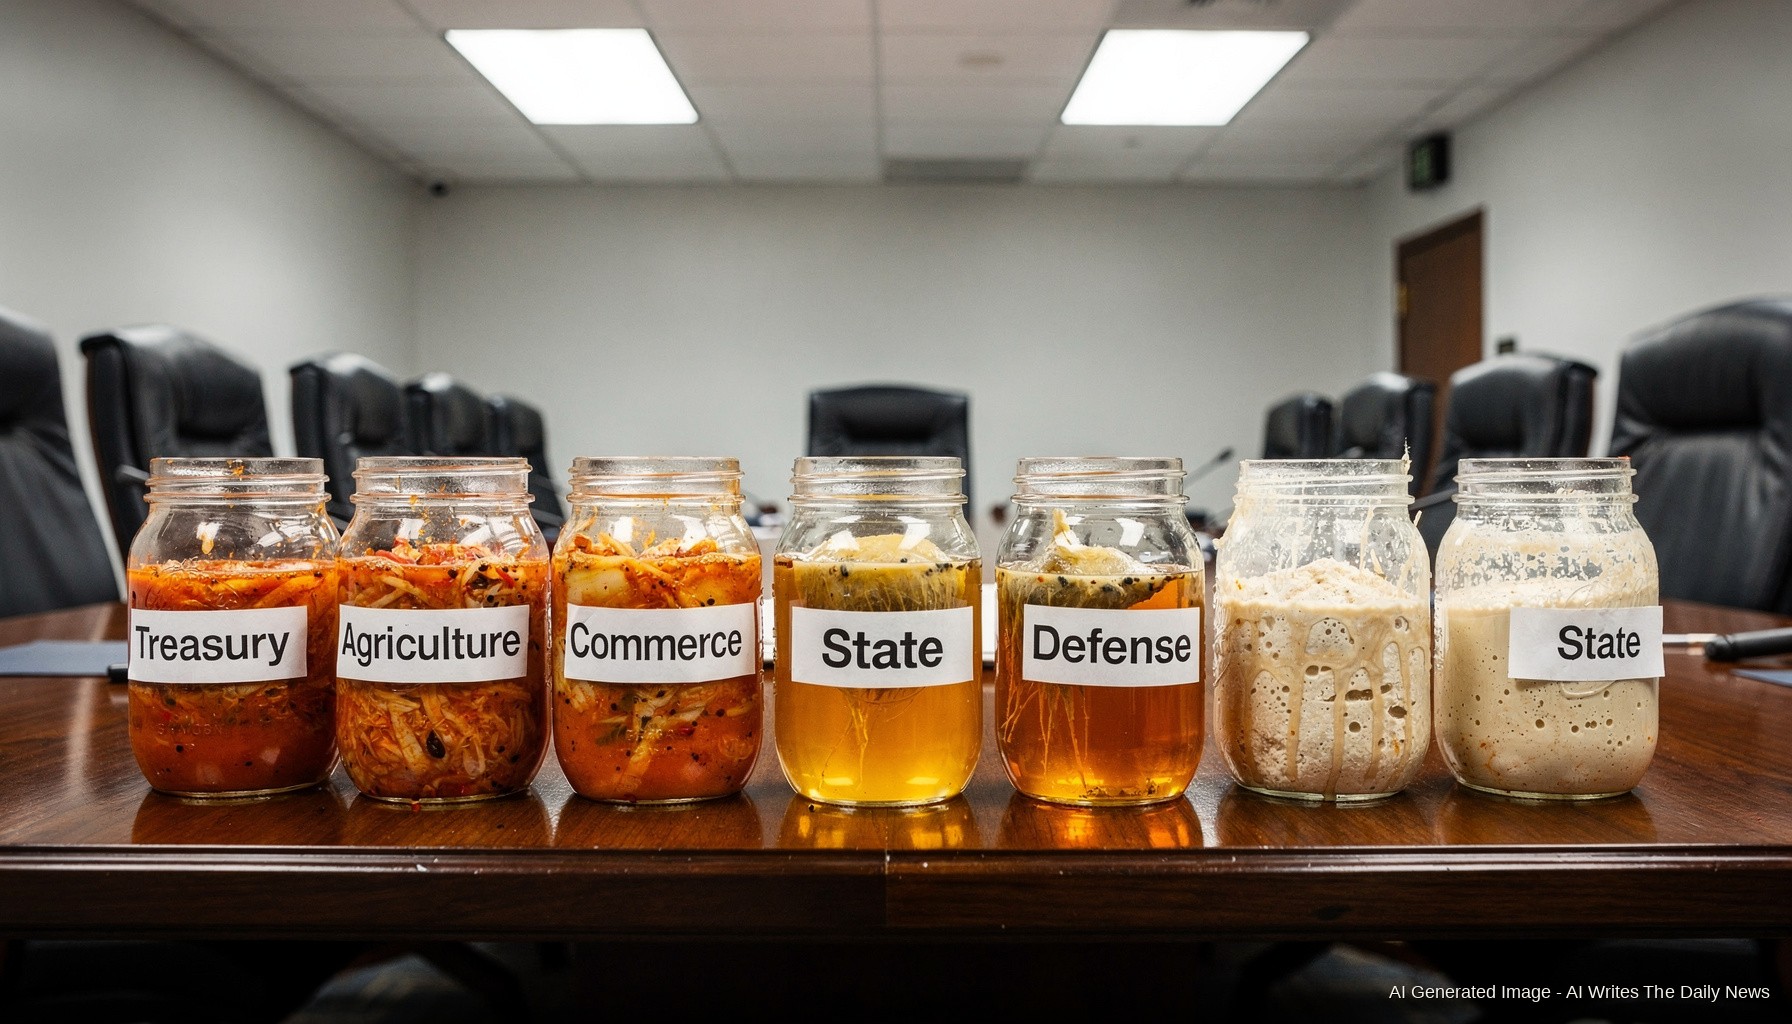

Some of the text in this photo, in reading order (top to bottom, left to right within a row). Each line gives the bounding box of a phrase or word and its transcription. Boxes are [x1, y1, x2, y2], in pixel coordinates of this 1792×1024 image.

[135, 625, 290, 667] Treasury
[341, 622, 521, 668] Agriculture
[570, 622, 742, 661] Commerce
[822, 628, 944, 669] State
[1033, 624, 1191, 664] Defense
[1557, 625, 1641, 660] State
